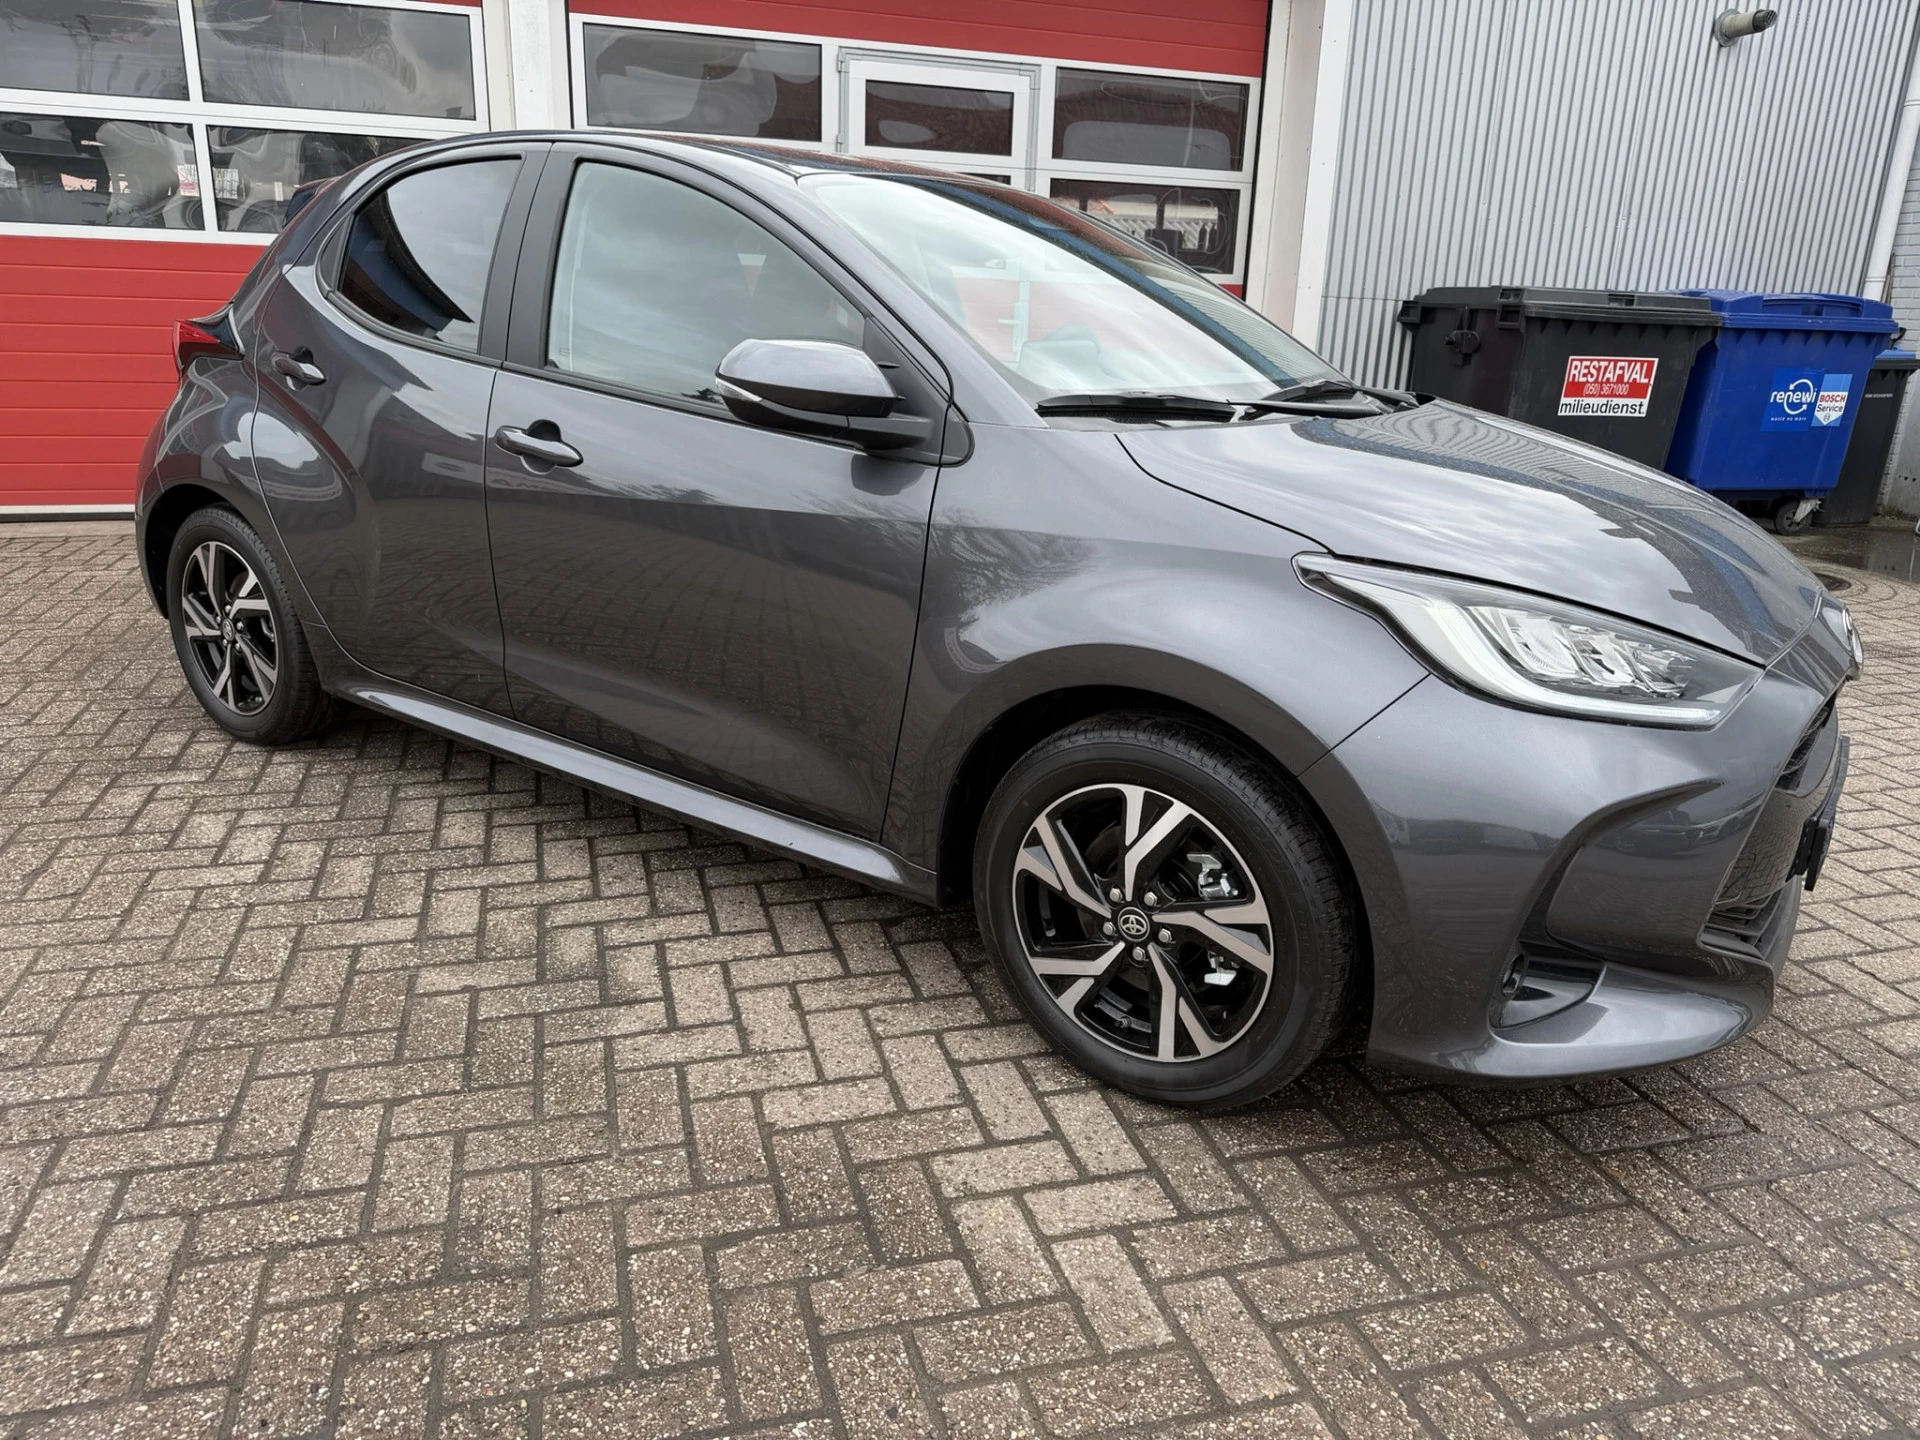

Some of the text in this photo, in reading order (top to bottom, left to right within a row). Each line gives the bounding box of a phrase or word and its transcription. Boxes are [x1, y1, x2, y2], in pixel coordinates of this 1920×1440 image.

[1569, 361, 1649, 382] RESTAFVAL
[1583, 383, 1629, 397] (050) 3671000
[1770, 387, 1818, 403] renewi
[1819, 394, 1846, 403] BOSCH
[1816, 403, 1844, 413] Service
